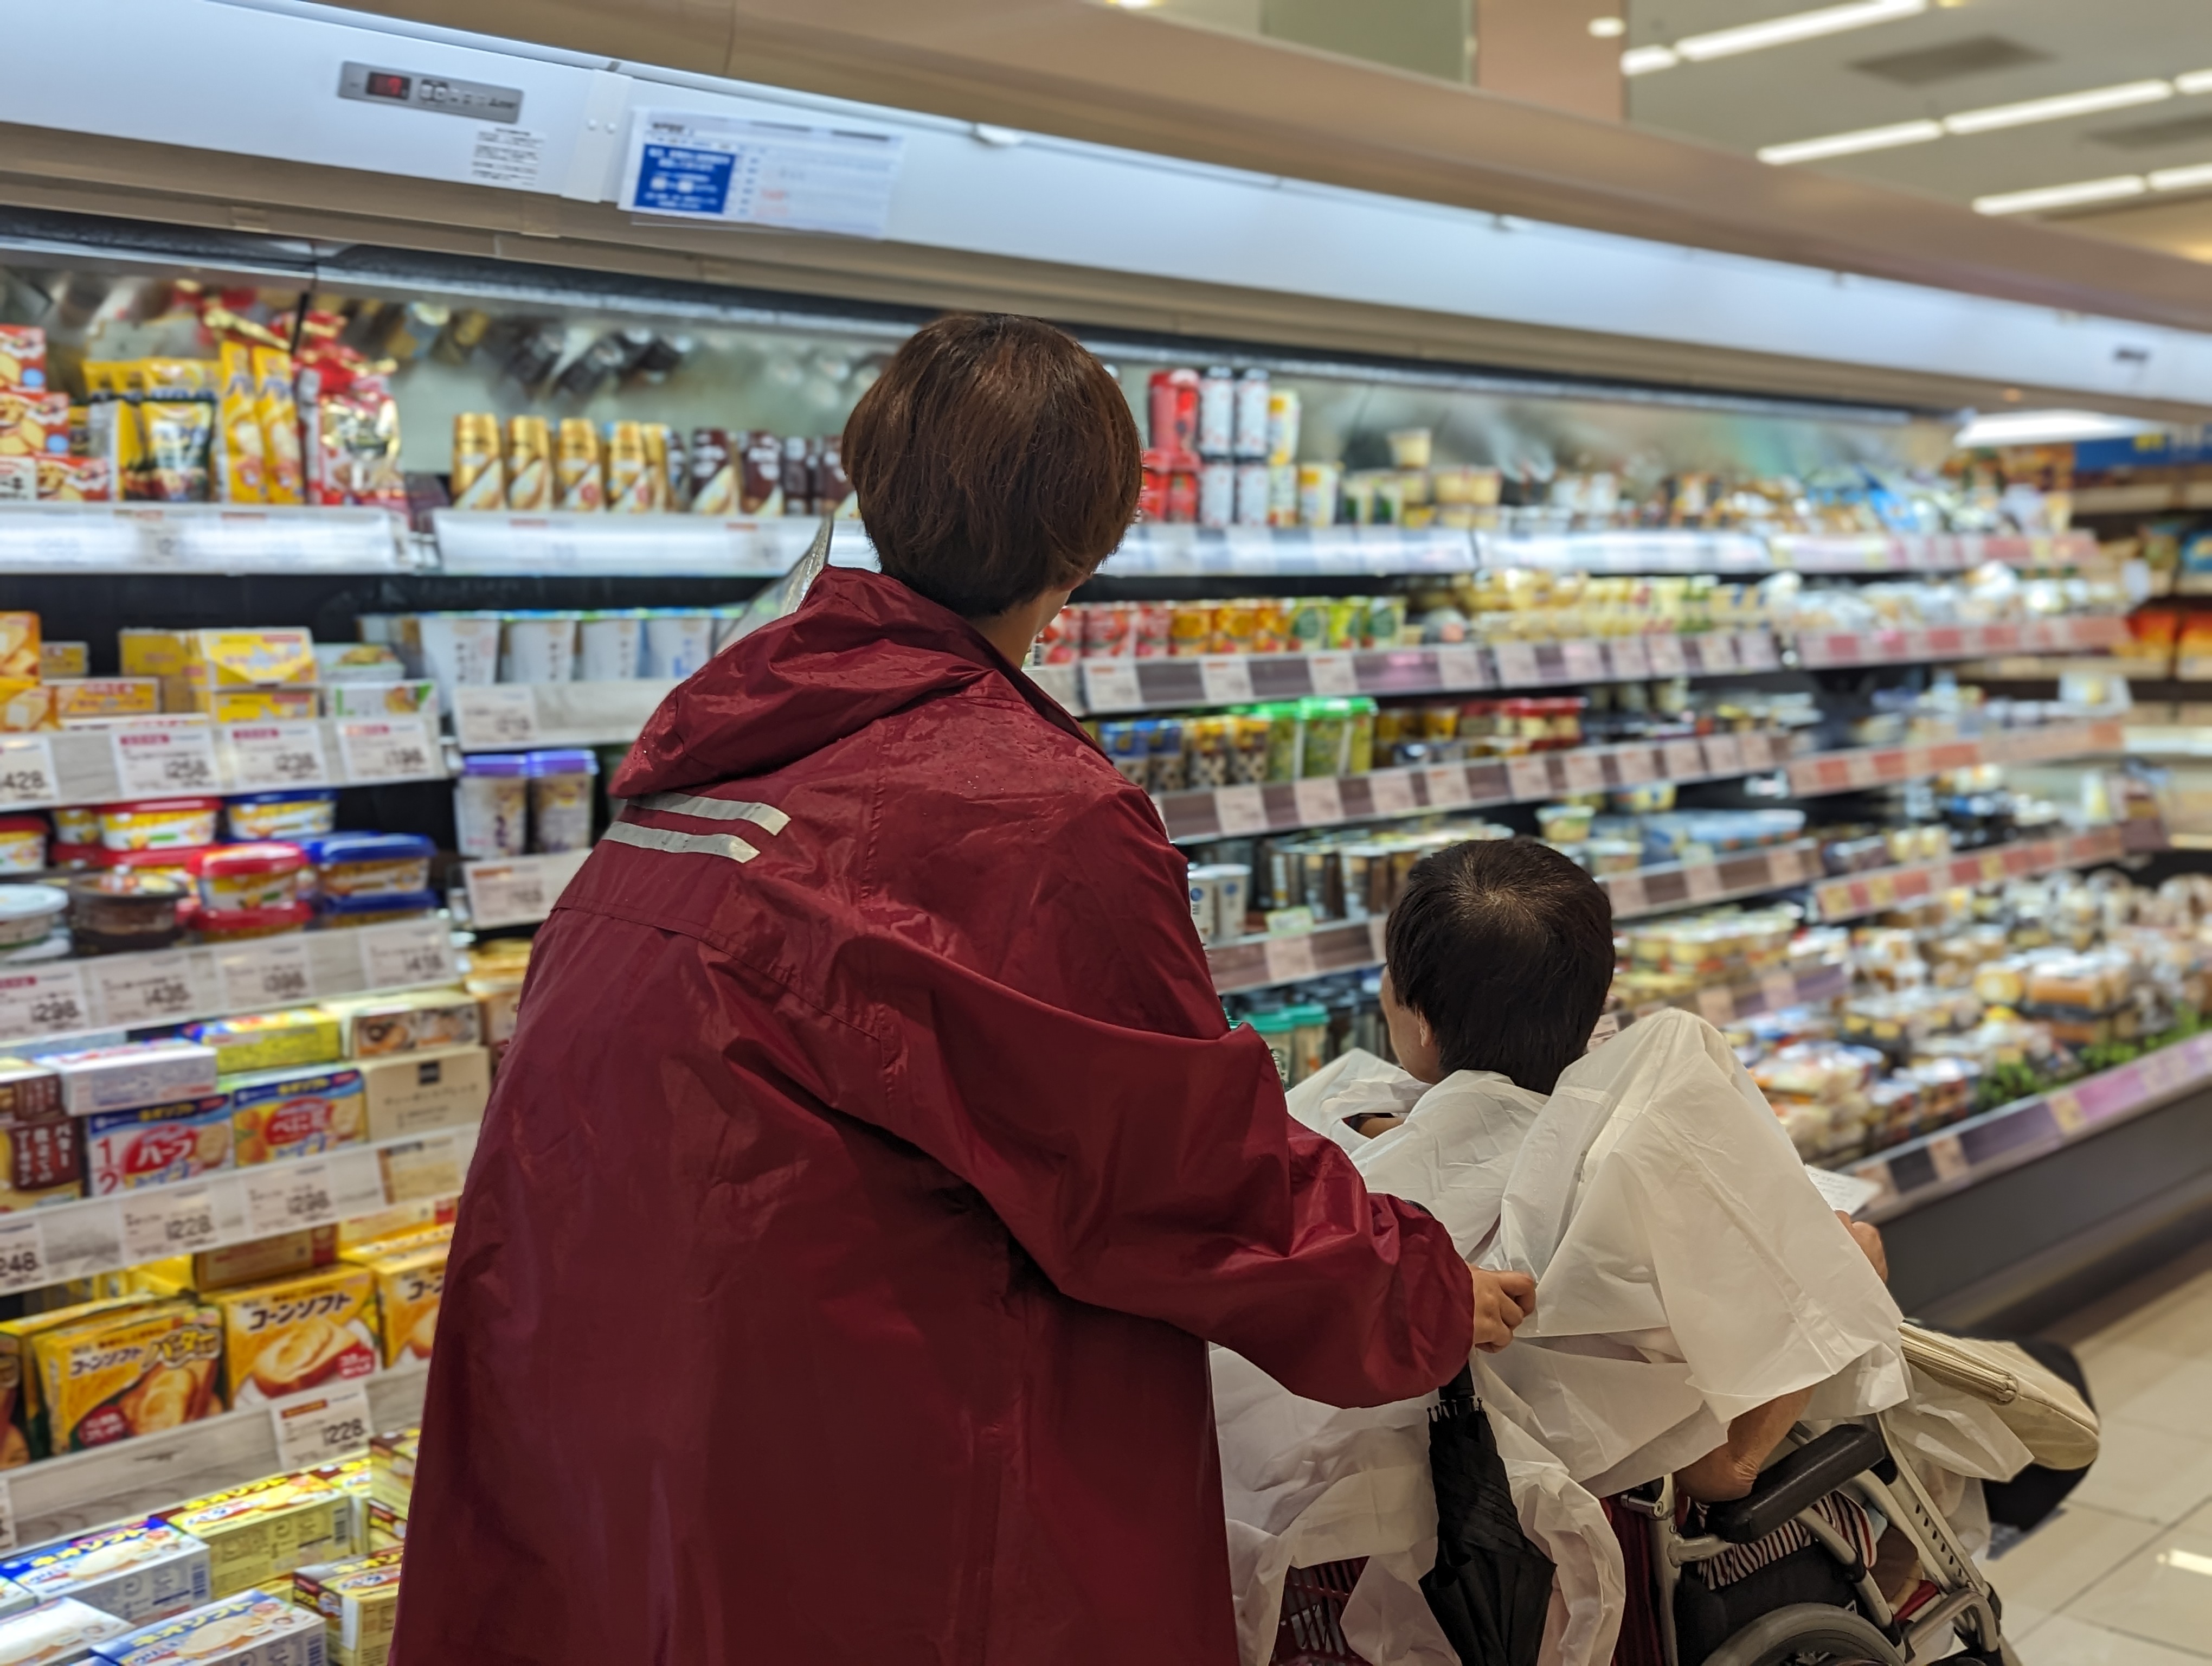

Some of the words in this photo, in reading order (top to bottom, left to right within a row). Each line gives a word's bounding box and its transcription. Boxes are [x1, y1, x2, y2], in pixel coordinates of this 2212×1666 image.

[3, 770, 45, 790] 428
[135, 1139, 192, 1167] ハーフ
[248, 1292, 352, 1331] コーンソフト
[70, 1347, 143, 1377] コーンソフト
[328, 1418, 364, 1444] 228
[131, 1601, 254, 1646] ネオソフト
